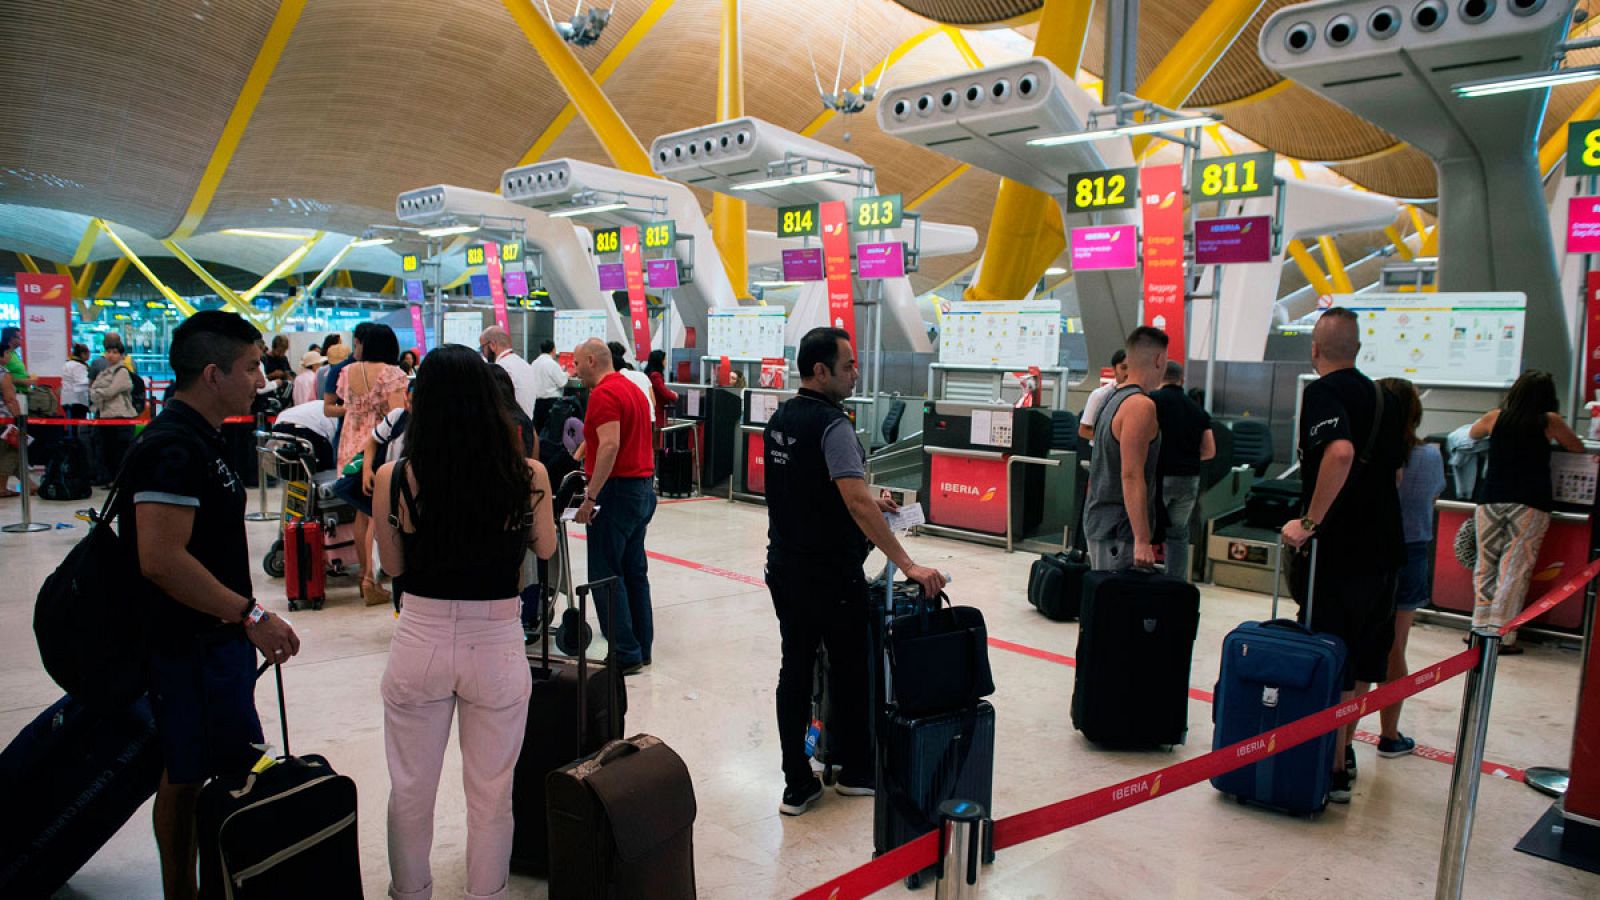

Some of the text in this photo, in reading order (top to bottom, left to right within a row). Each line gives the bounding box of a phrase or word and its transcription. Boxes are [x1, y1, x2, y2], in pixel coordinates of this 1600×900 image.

[1201, 160, 1258, 196] 811
[1076, 174, 1125, 208] 812
[783, 210, 813, 233] 814
[858, 200, 893, 226] 813
[596, 231, 618, 252] 816
[646, 225, 669, 246] 815
[24, 284, 42, 293] IB
[940, 482, 980, 496] IBERIA
[1335, 703, 1359, 719] IBERIA
[1237, 739, 1266, 757] IBERIA
[1112, 780, 1149, 801] IBERIA
